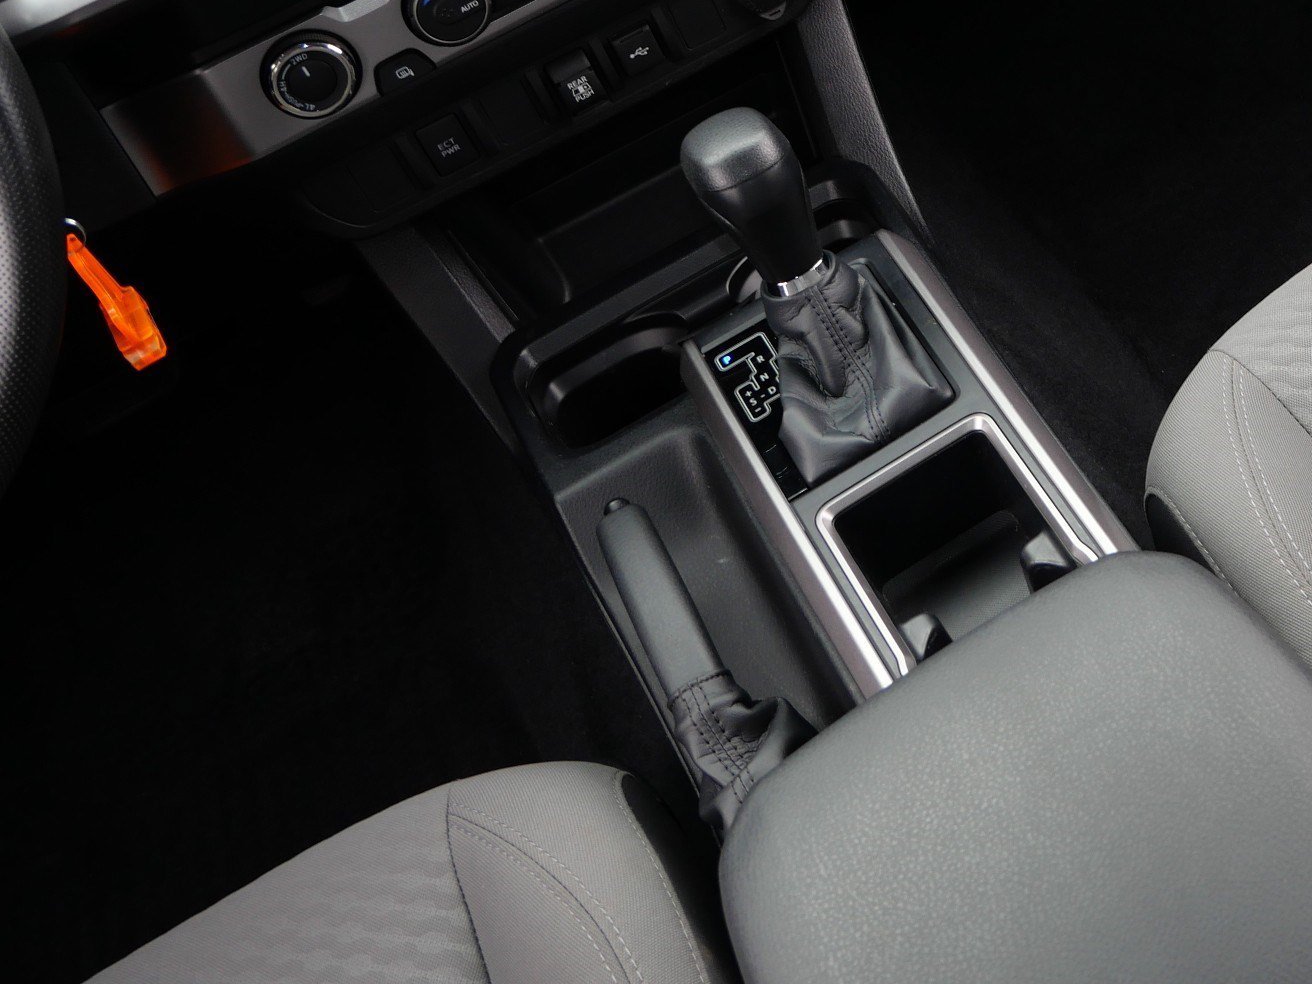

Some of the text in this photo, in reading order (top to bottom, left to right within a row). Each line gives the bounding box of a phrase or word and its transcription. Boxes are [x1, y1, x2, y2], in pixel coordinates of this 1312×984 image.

[460, 0, 479, 14] AUTO
[566, 75, 589, 91] REAR
[574, 88, 595, 103] PUSH
[437, 137, 455, 152] ECT
[441, 143, 461, 158] PWR
[756, 354, 766, 364] R
[759, 372, 770, 382] N
[767, 385, 777, 395] D
[749, 397, 758, 407] S
